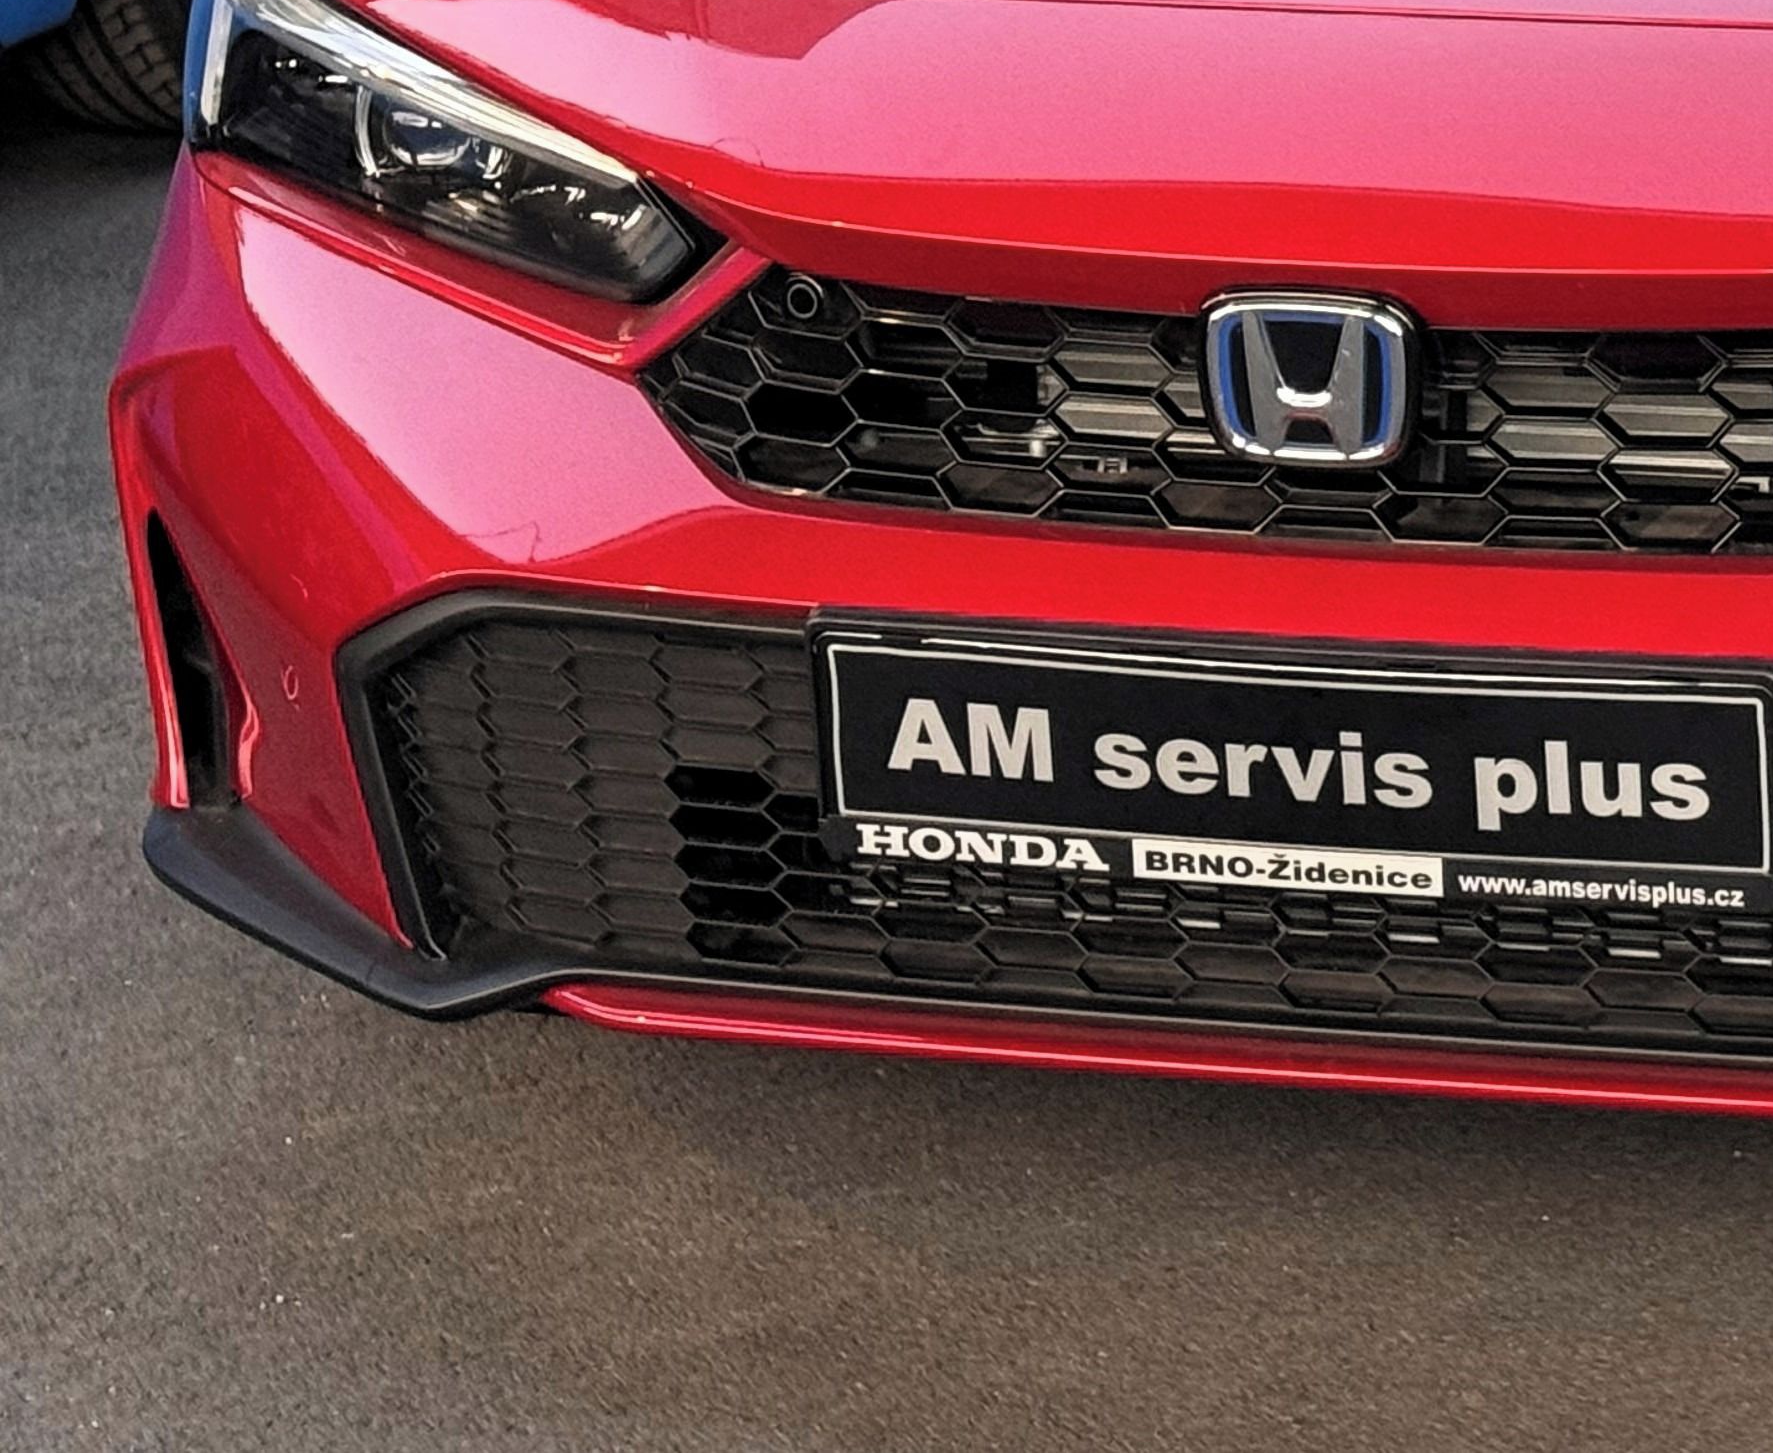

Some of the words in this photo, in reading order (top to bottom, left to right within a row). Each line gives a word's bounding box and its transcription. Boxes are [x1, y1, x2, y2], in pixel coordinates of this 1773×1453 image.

[887, 698, 1054, 782] AM
[1094, 731, 1433, 809] servis
[1474, 740, 1710, 831] plus
[855, 823, 1110, 872] HONDA
[1145, 850, 1432, 889] BRNO-Židenice
[1457, 874, 1745, 909] www.amservisplus.cz
